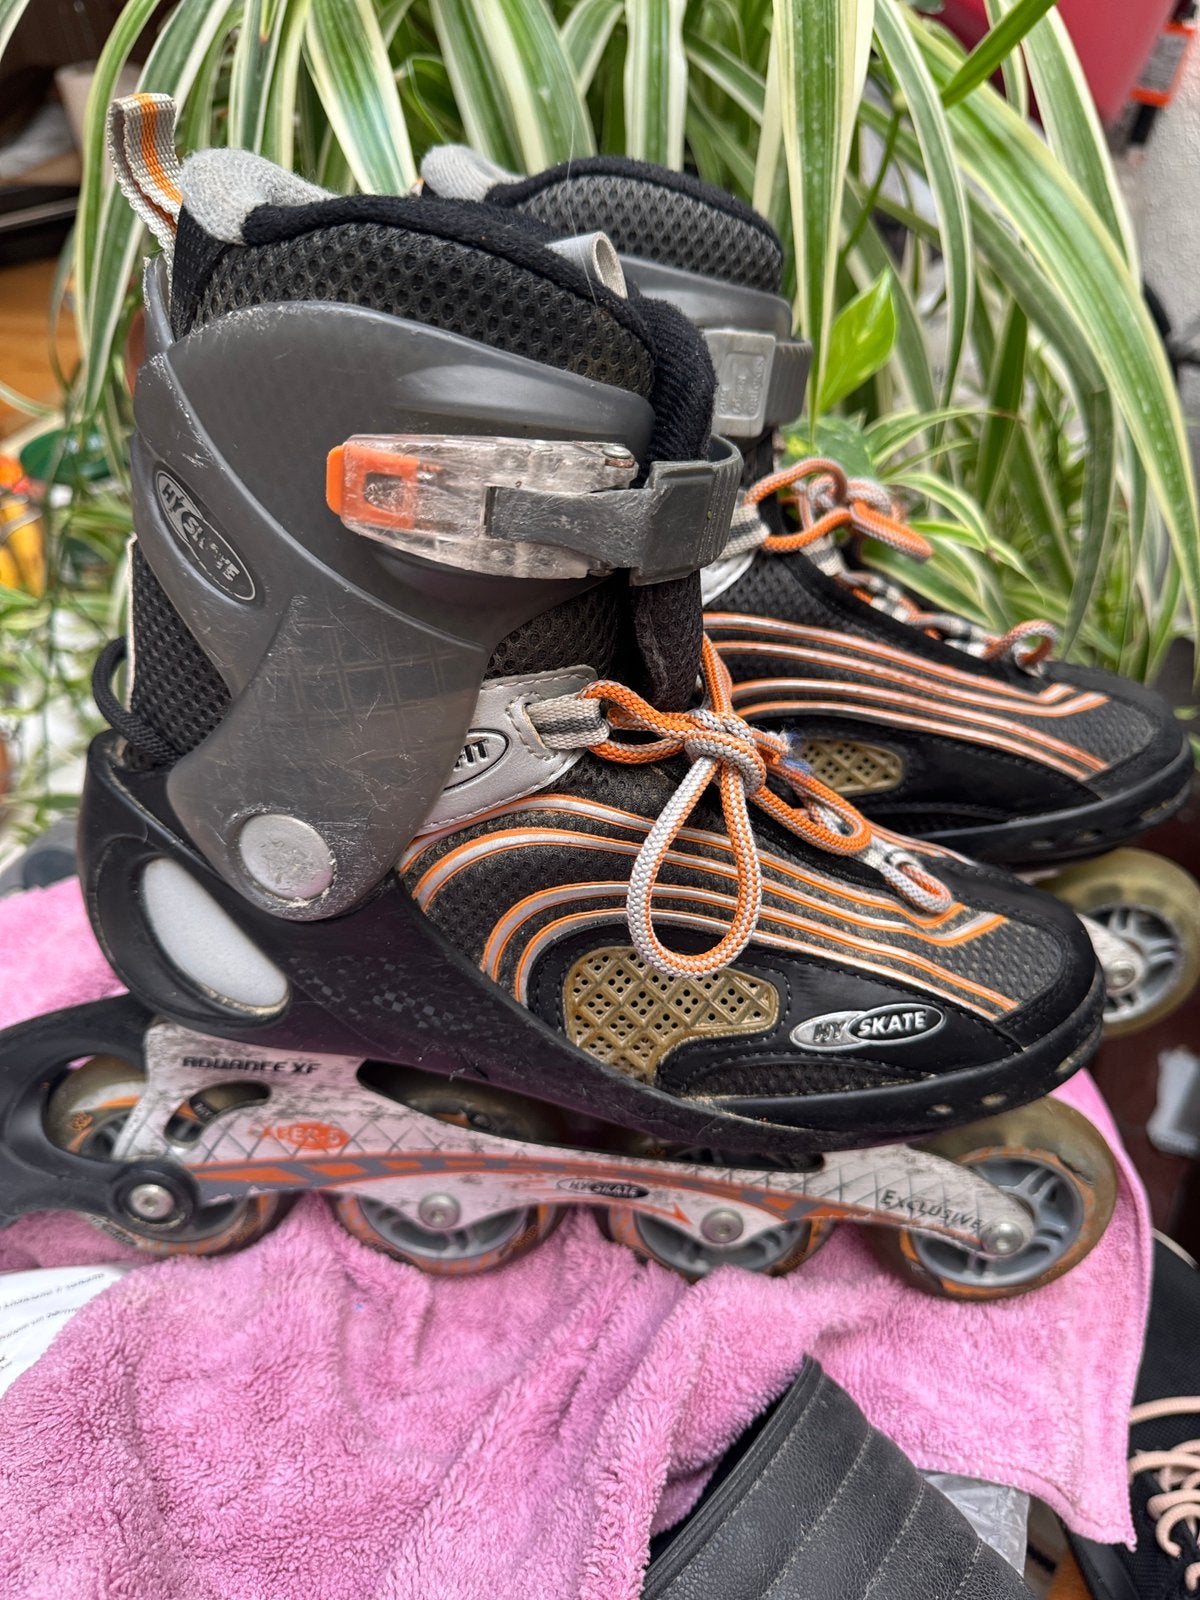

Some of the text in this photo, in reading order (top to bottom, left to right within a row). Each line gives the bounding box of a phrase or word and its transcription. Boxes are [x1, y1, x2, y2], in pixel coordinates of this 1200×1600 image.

[162, 484, 185, 512] HY
[812, 1011, 927, 1043] HY SKATE
[592, 1183, 638, 1196] SKATE
[880, 1188, 985, 1231] EXCLUSIVE
